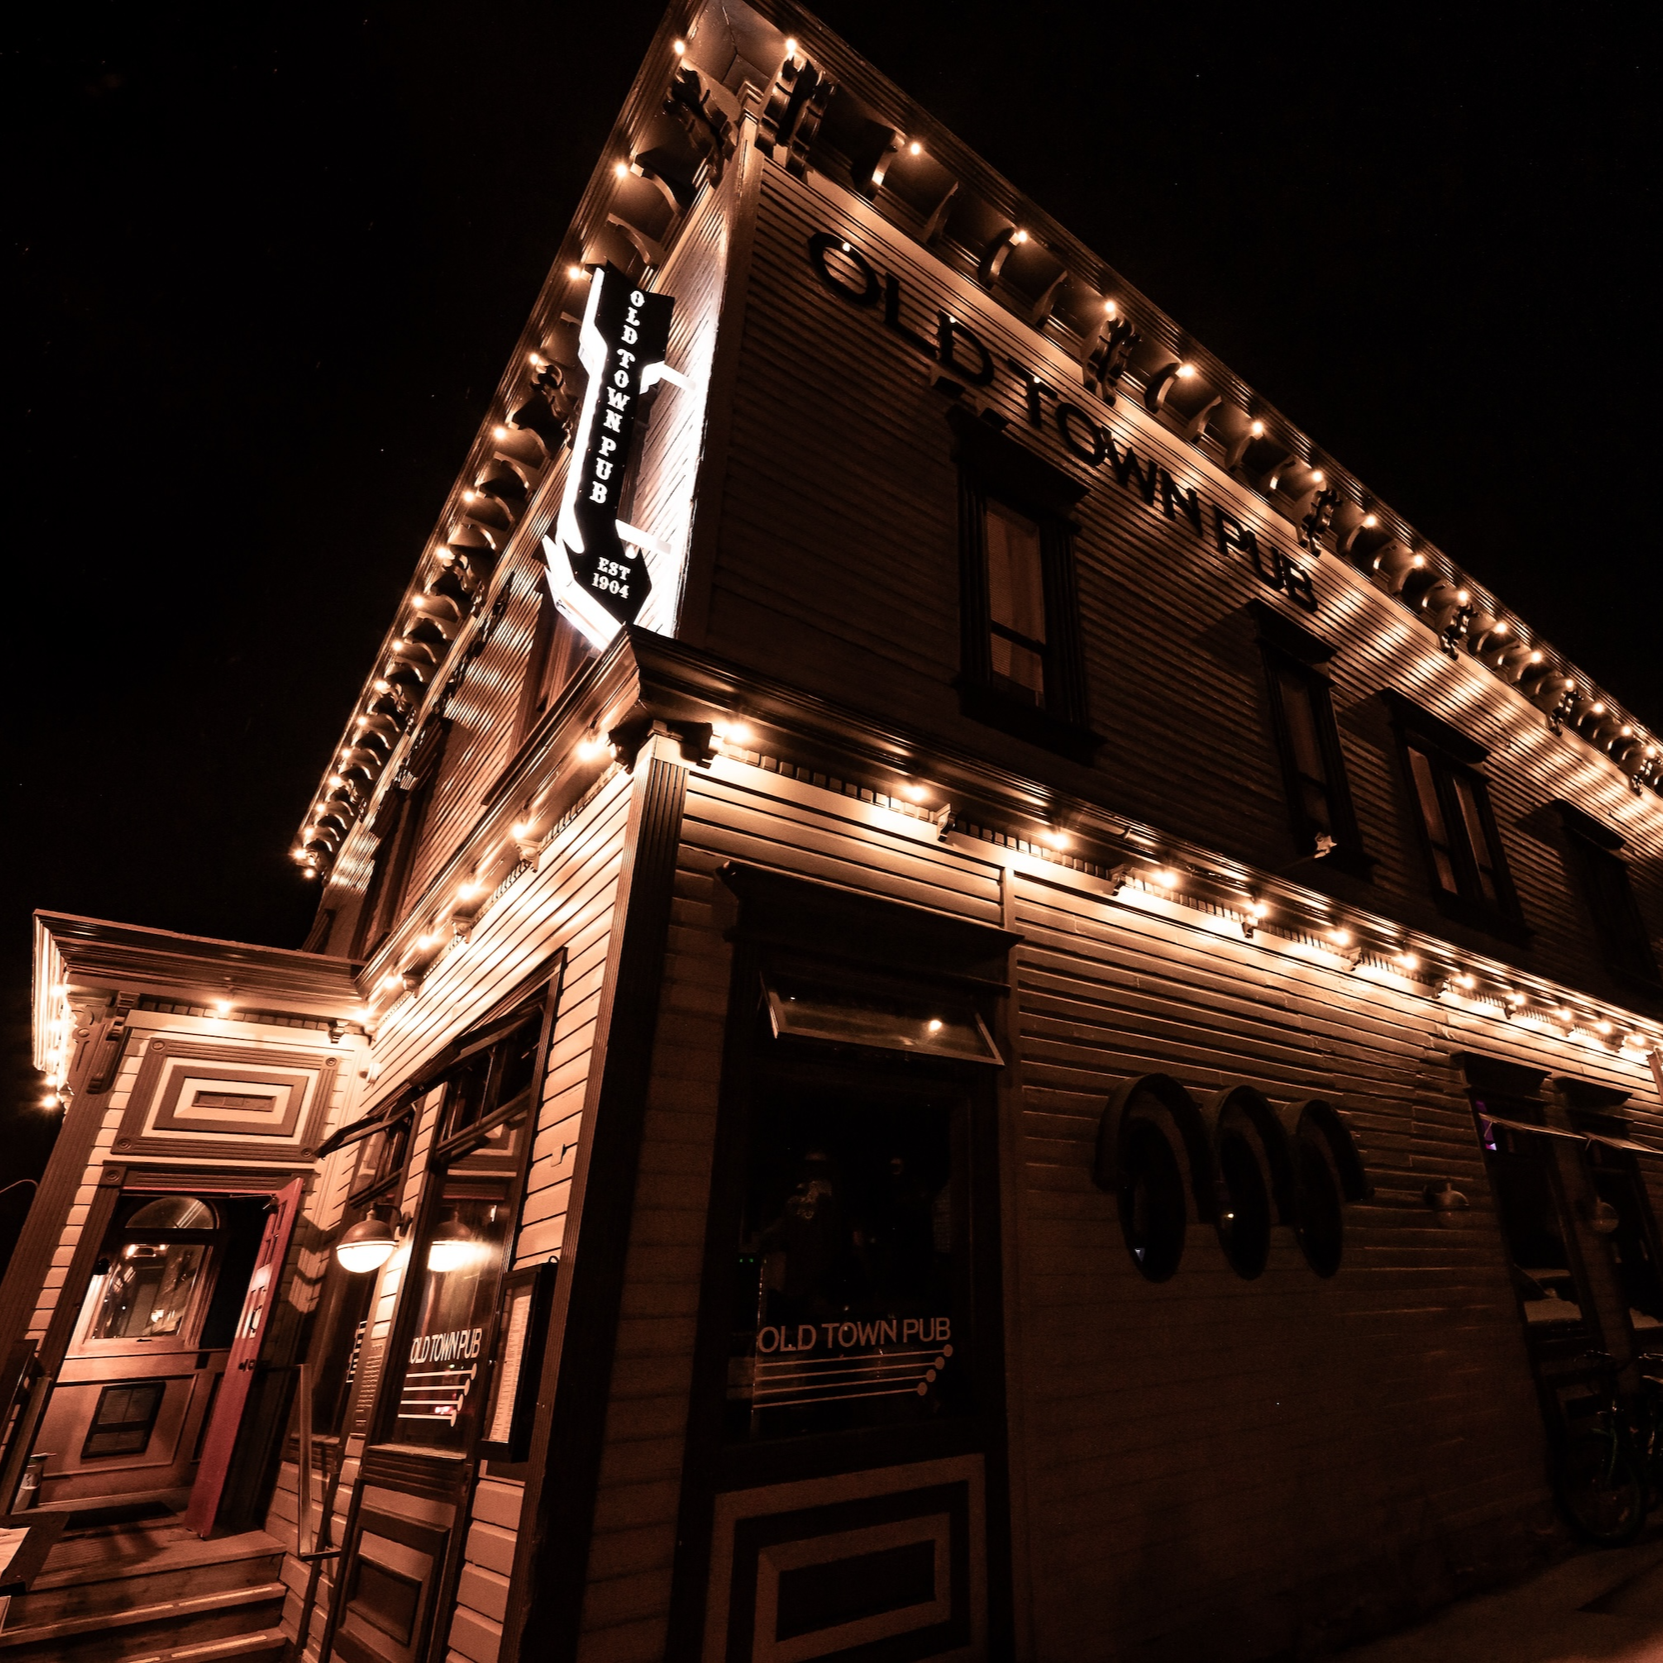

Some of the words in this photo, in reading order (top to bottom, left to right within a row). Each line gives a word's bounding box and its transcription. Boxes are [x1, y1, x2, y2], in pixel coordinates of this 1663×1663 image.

[622, 290, 645, 345] OLD
[605, 348, 635, 433] TOWN
[808, 231, 994, 385] OLD
[1008, 357, 1203, 537] TOWN
[1213, 505, 1317, 613] PUB
[590, 435, 617, 504] PUB
[591, 572, 630, 599] 1904
[597, 556, 632, 582] EST
[409, 1335, 431, 1364] OLD
[429, 1331, 460, 1362] TOWN
[457, 1328, 483, 1359] PUB
[758, 1324, 817, 1353] OLD
[821, 1319, 898, 1348] TOWN
[903, 1317, 950, 1343] PUB
